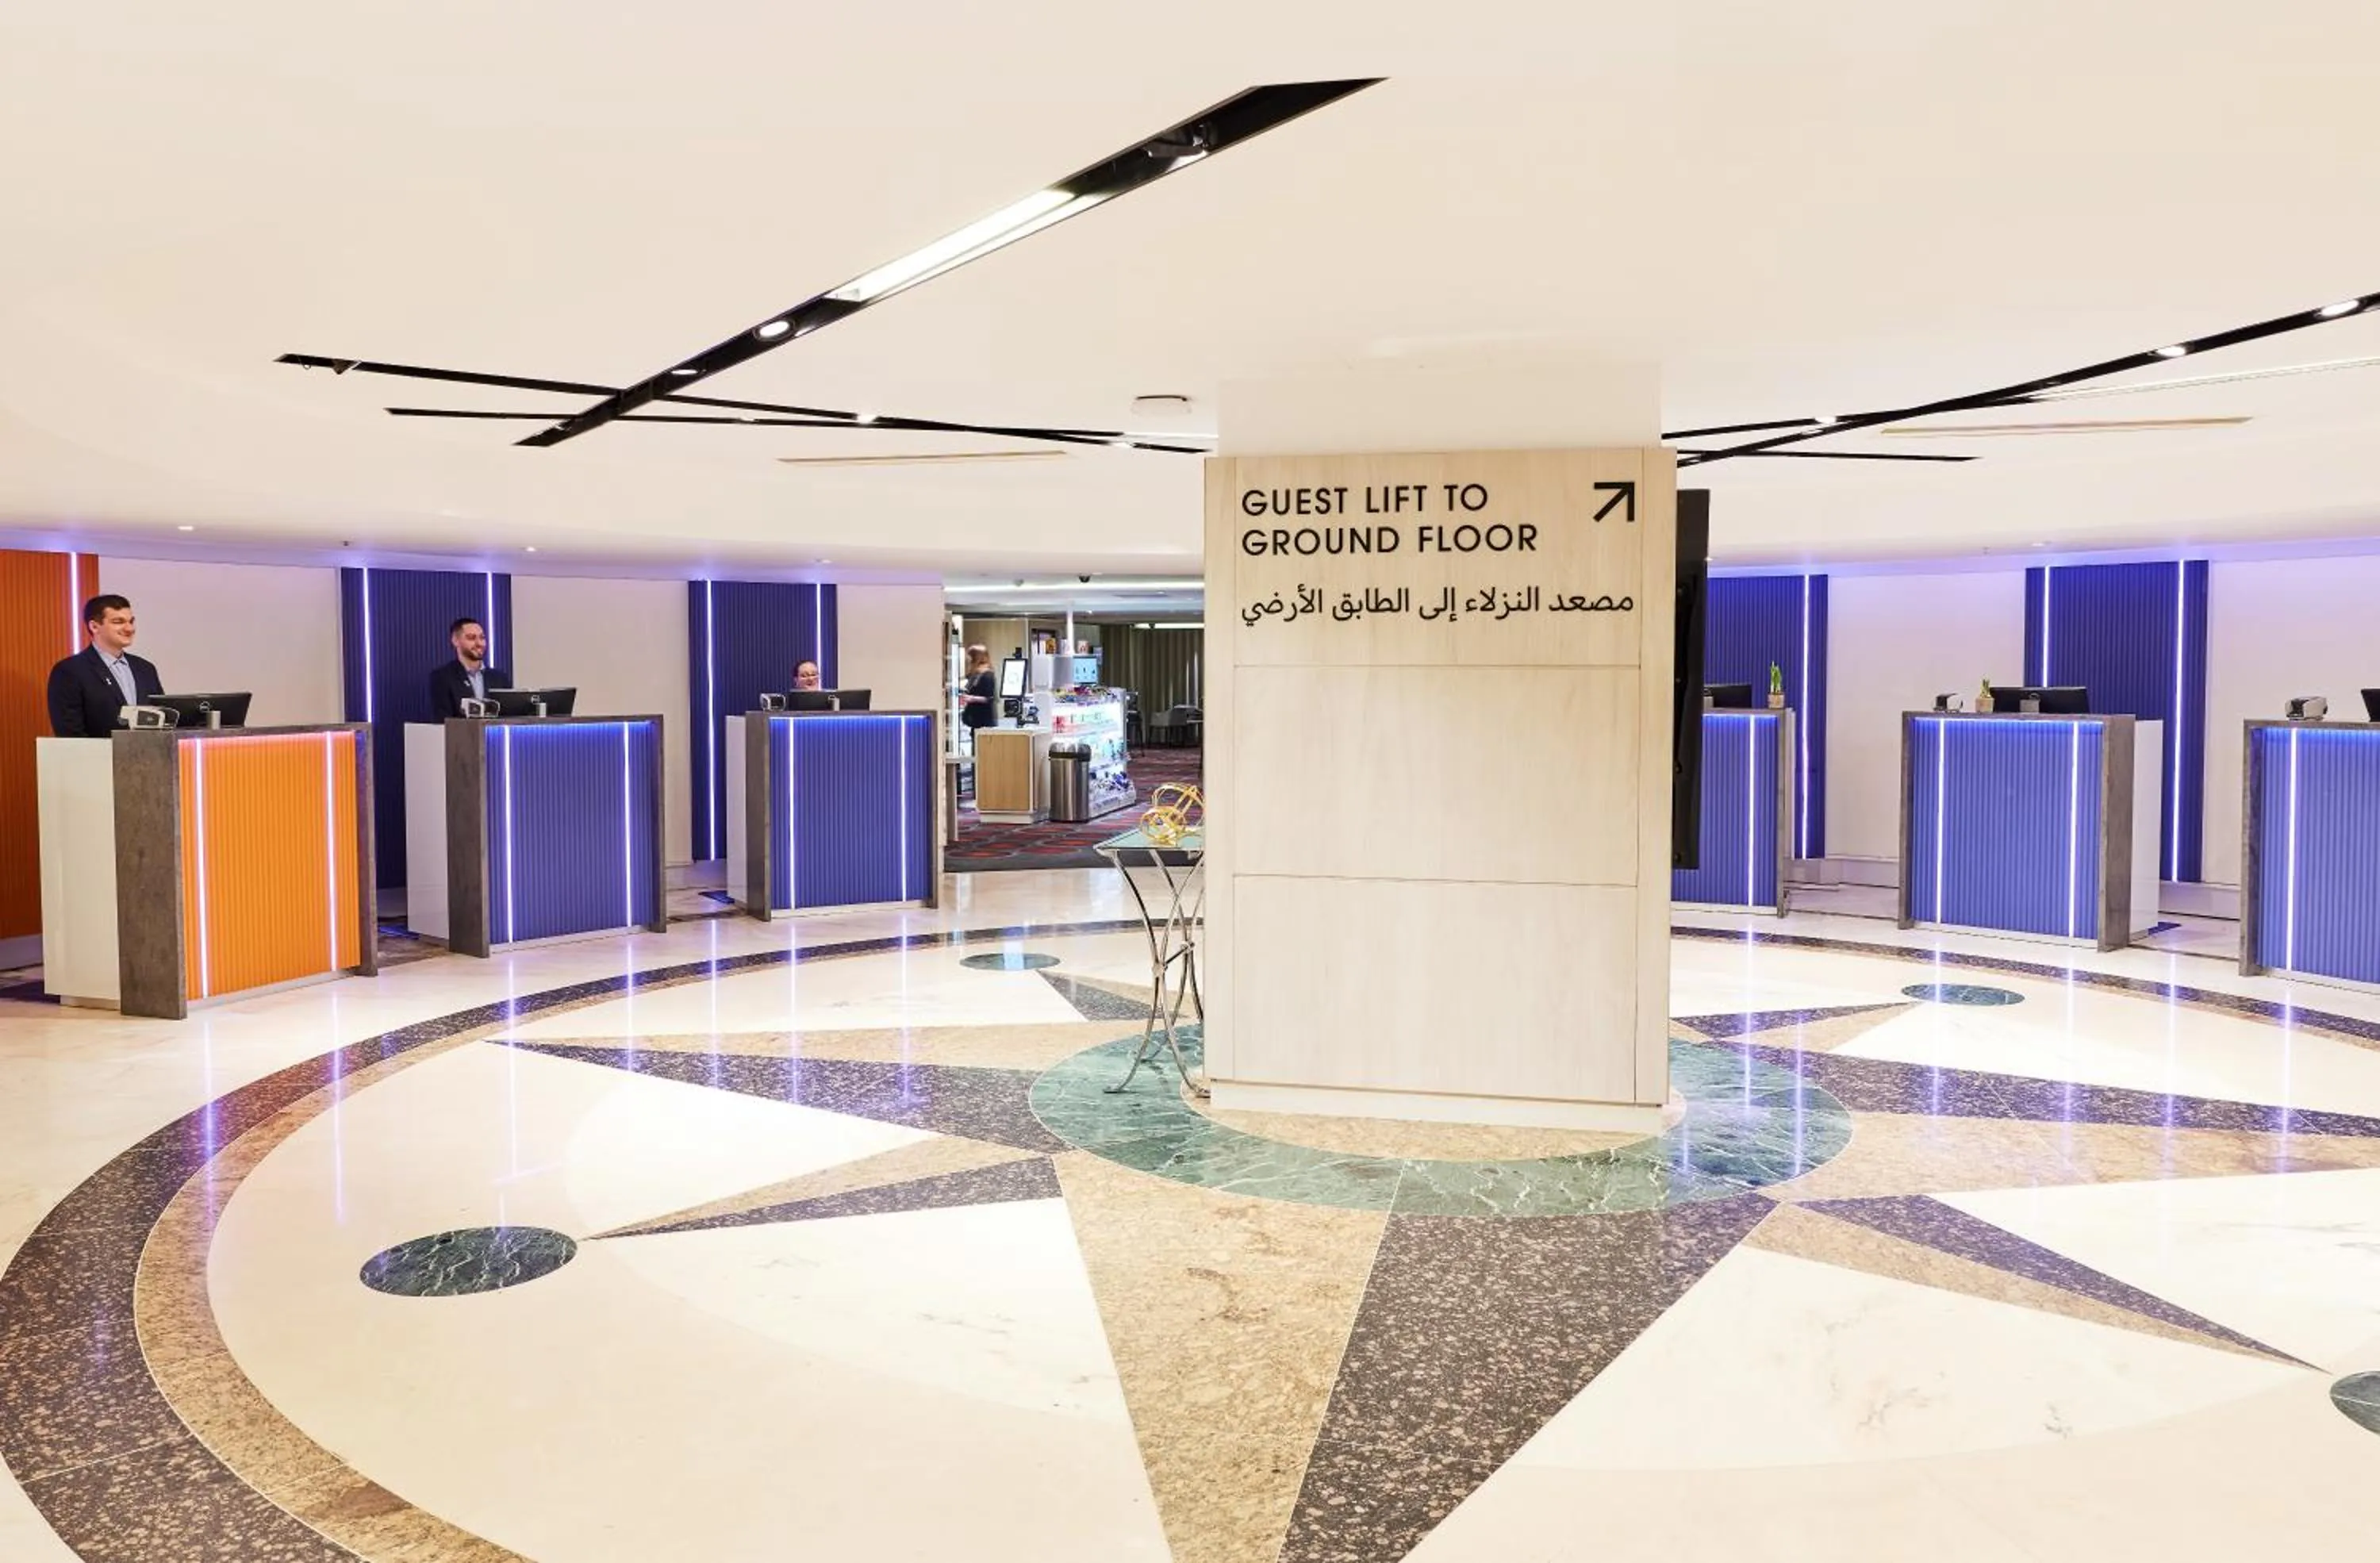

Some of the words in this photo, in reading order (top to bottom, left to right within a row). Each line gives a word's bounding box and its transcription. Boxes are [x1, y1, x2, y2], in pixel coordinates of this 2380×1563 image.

[1242, 486, 1349, 517] GUEST
[1365, 485, 1428, 514] LIFT
[1443, 483, 1488, 512] TO
[1242, 526, 1400, 556] GROUND
[1418, 523, 1537, 553] FLOOR
[1242, 583, 1322, 628] الأرضي
[1332, 587, 1410, 622] الطابق
[1418, 586, 1457, 623] إلى
[1465, 586, 1540, 620] النزلاء
[1548, 593, 1633, 612] مصعد
